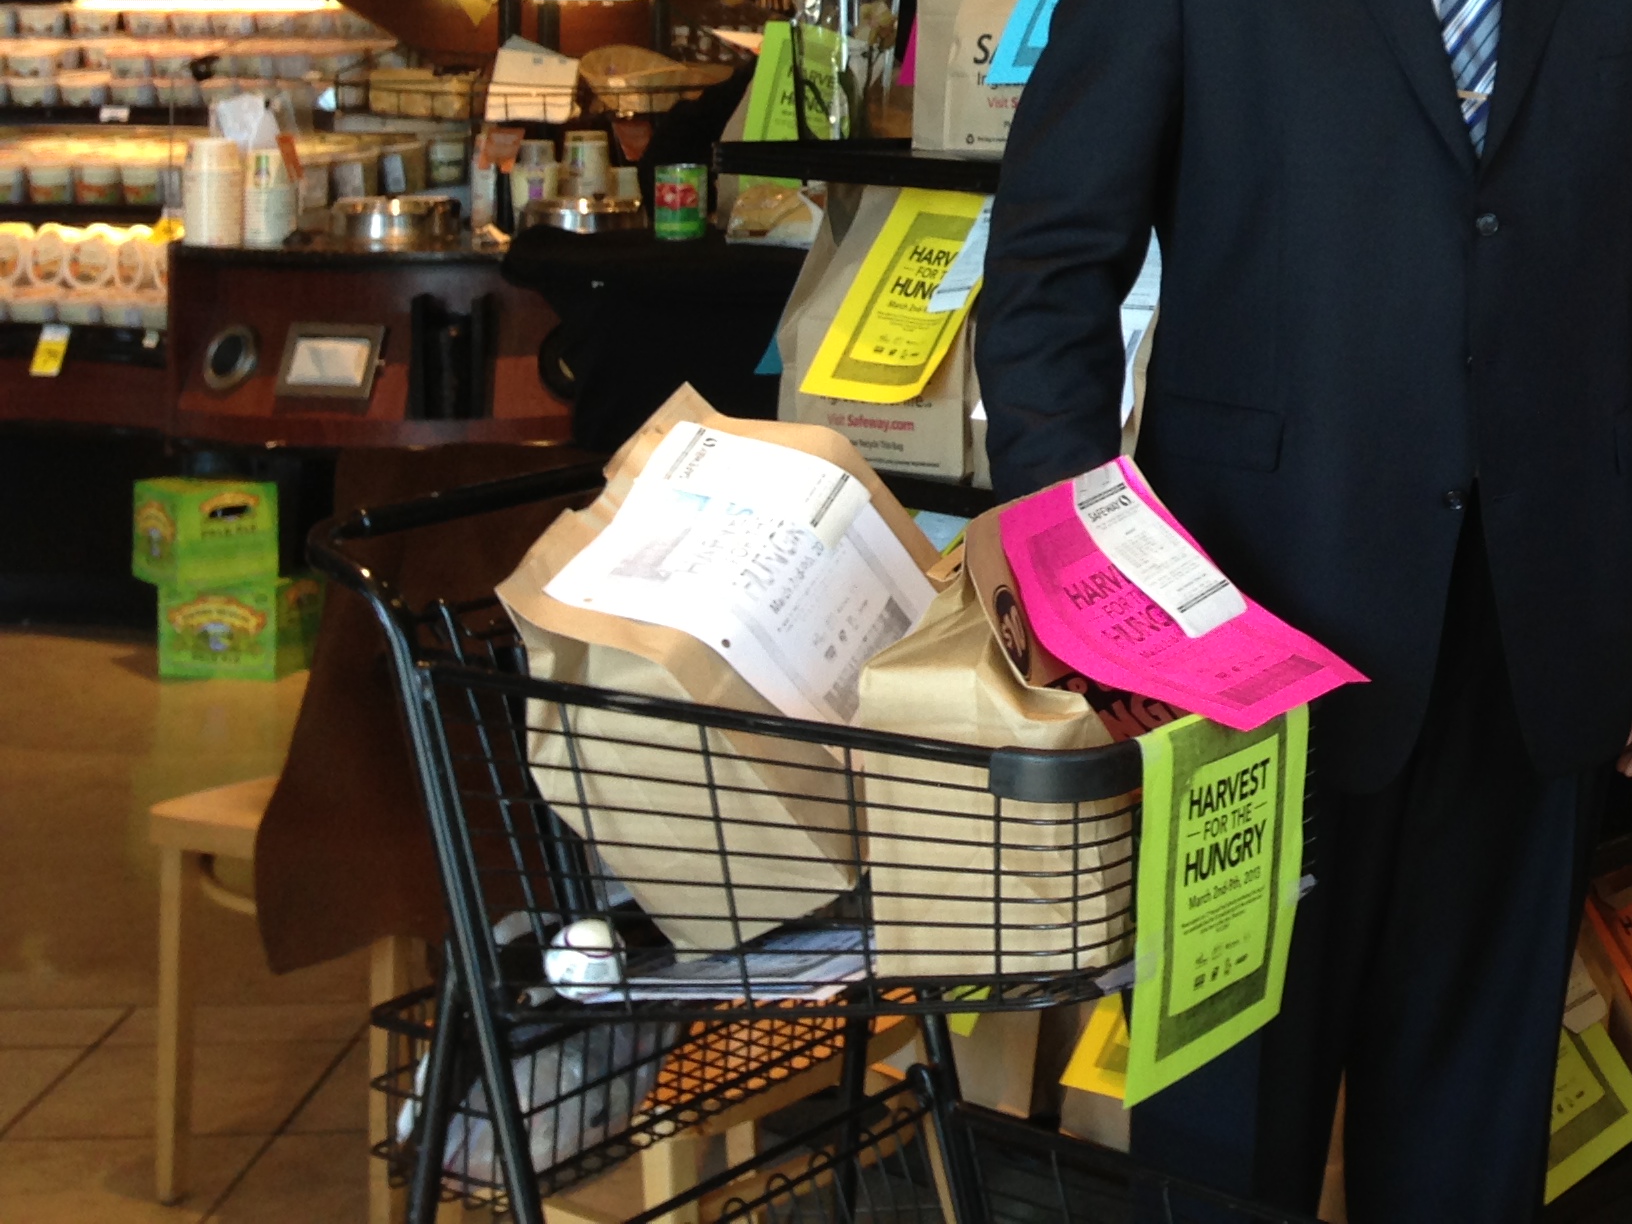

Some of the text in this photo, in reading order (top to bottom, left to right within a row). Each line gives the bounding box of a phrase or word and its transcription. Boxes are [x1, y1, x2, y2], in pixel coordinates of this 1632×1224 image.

[973, 33, 999, 65] S
[914, 265, 938, 280] FOR
[1188, 757, 1270, 821] HARVEST
[1203, 802, 1253, 840] FOR THE
[1184, 818, 1267, 888] HUNGRY
